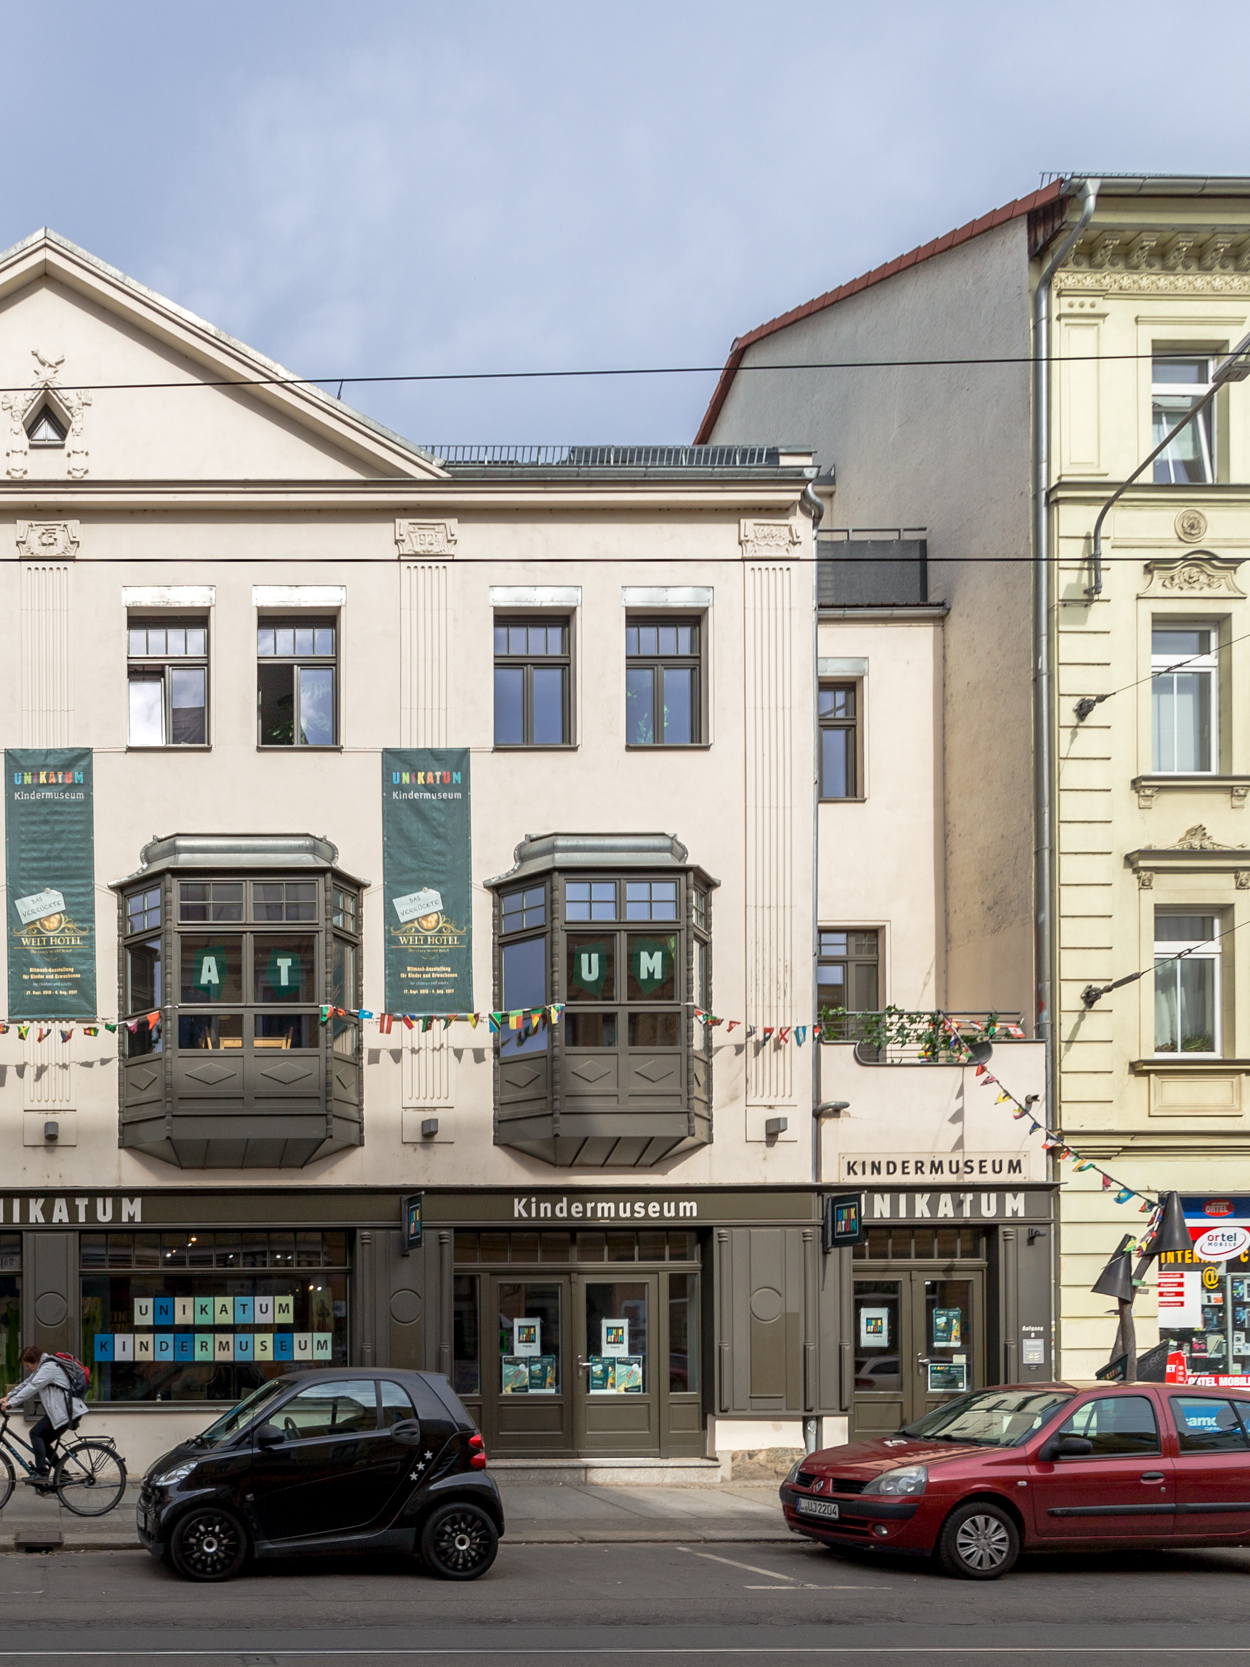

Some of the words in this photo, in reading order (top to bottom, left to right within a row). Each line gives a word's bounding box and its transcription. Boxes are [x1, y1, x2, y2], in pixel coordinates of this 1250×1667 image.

[14, 771, 84, 785] UNIKATUM
[392, 771, 461, 784] UNIKATUM
[14, 791, 84, 800] Kindermuseum
[392, 790, 462, 799] Kindermuseum
[22, 900, 62, 917] VERRÜCKTE
[401, 899, 439, 916] VERRÜCKTE
[21, 937, 47, 945] WELT
[50, 937, 82, 945] HOTEL
[399, 936, 425, 944] WELT
[428, 936, 459, 944] HOTEL
[847, 1159, 1022, 1176] KINDERMUSEUM
[514, 1197, 697, 1218] Kindermuseum
[862, 1193, 1025, 1218] NIKATUM
[1207, 1233, 1236, 1242] ortel
[139, 1303, 290, 1316] UNIKATUM
[100, 1340, 328, 1353] KINDERMUSEUM
